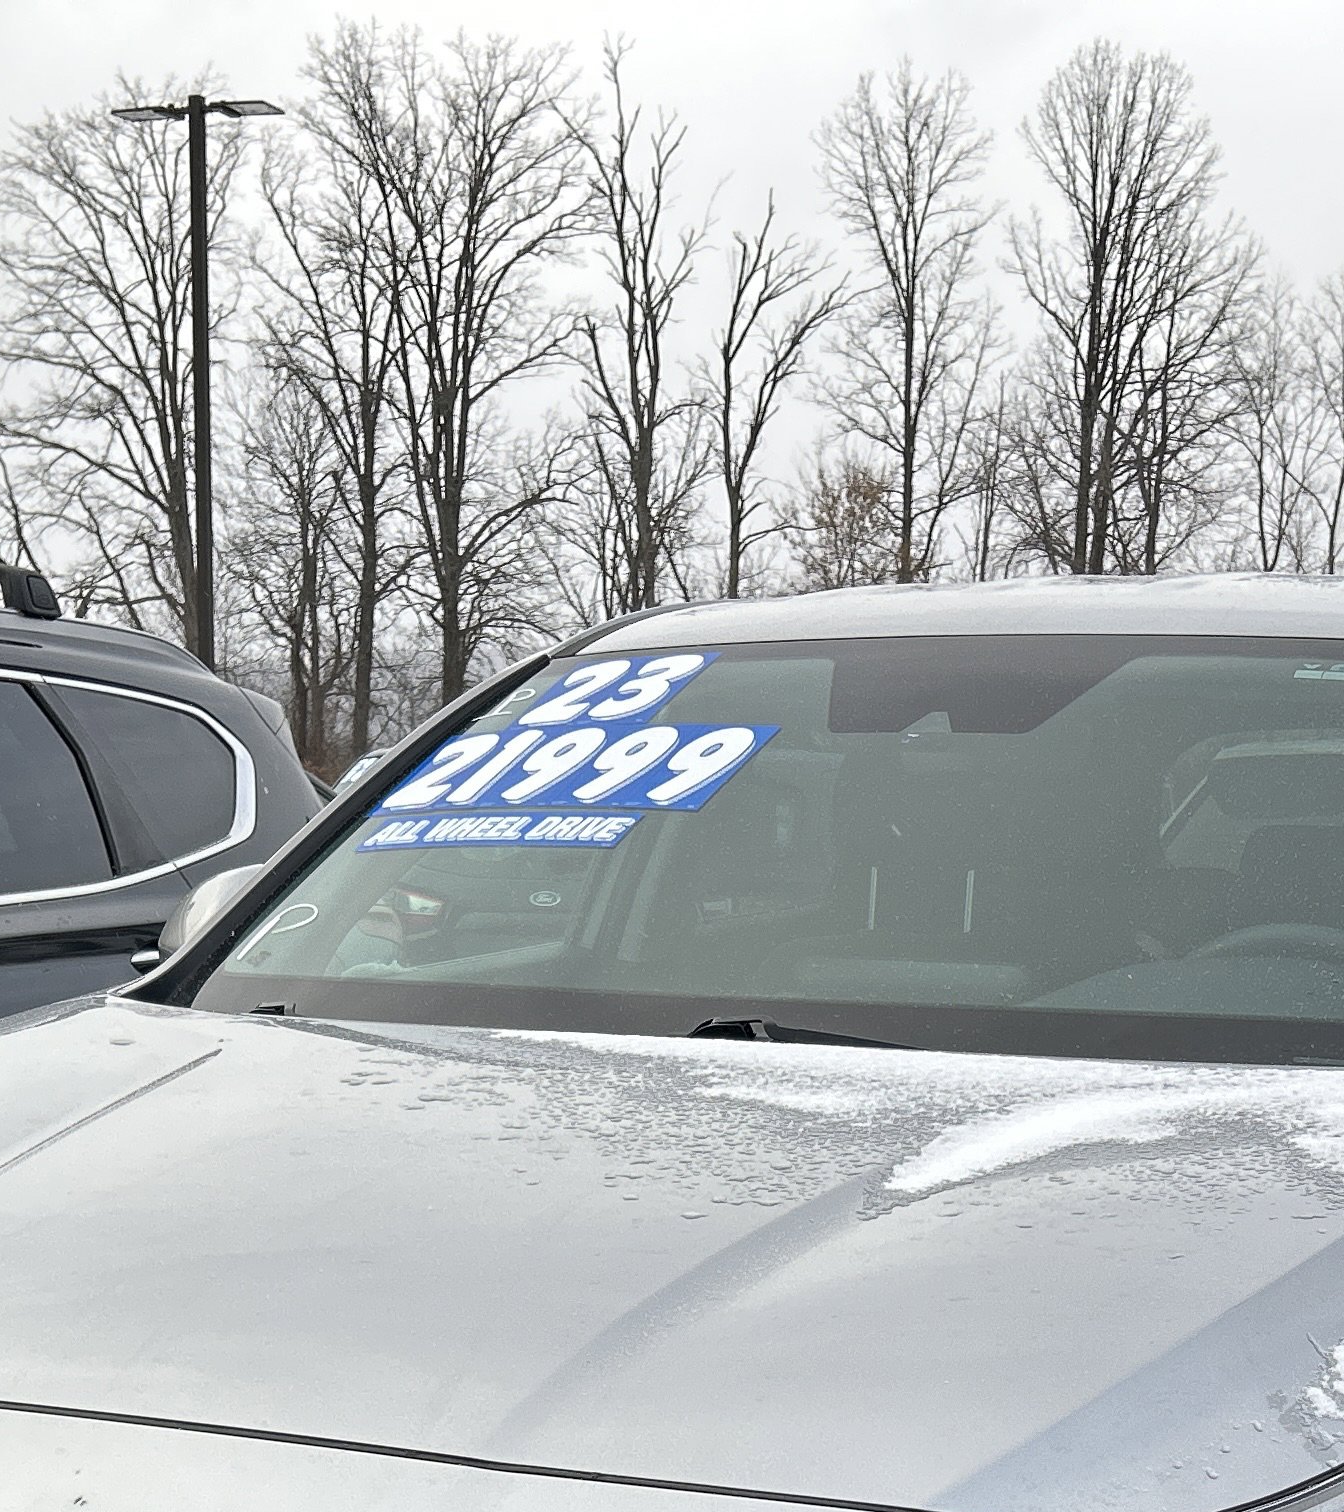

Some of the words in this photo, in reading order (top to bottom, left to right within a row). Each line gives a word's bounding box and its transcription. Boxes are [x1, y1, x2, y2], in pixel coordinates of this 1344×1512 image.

[518, 654, 706, 727] 23
[382, 726, 756, 811] 21999
[363, 819, 430, 847] ALL
[423, 816, 532, 843] WHEEL
[524, 816, 639, 842] DRIVE
